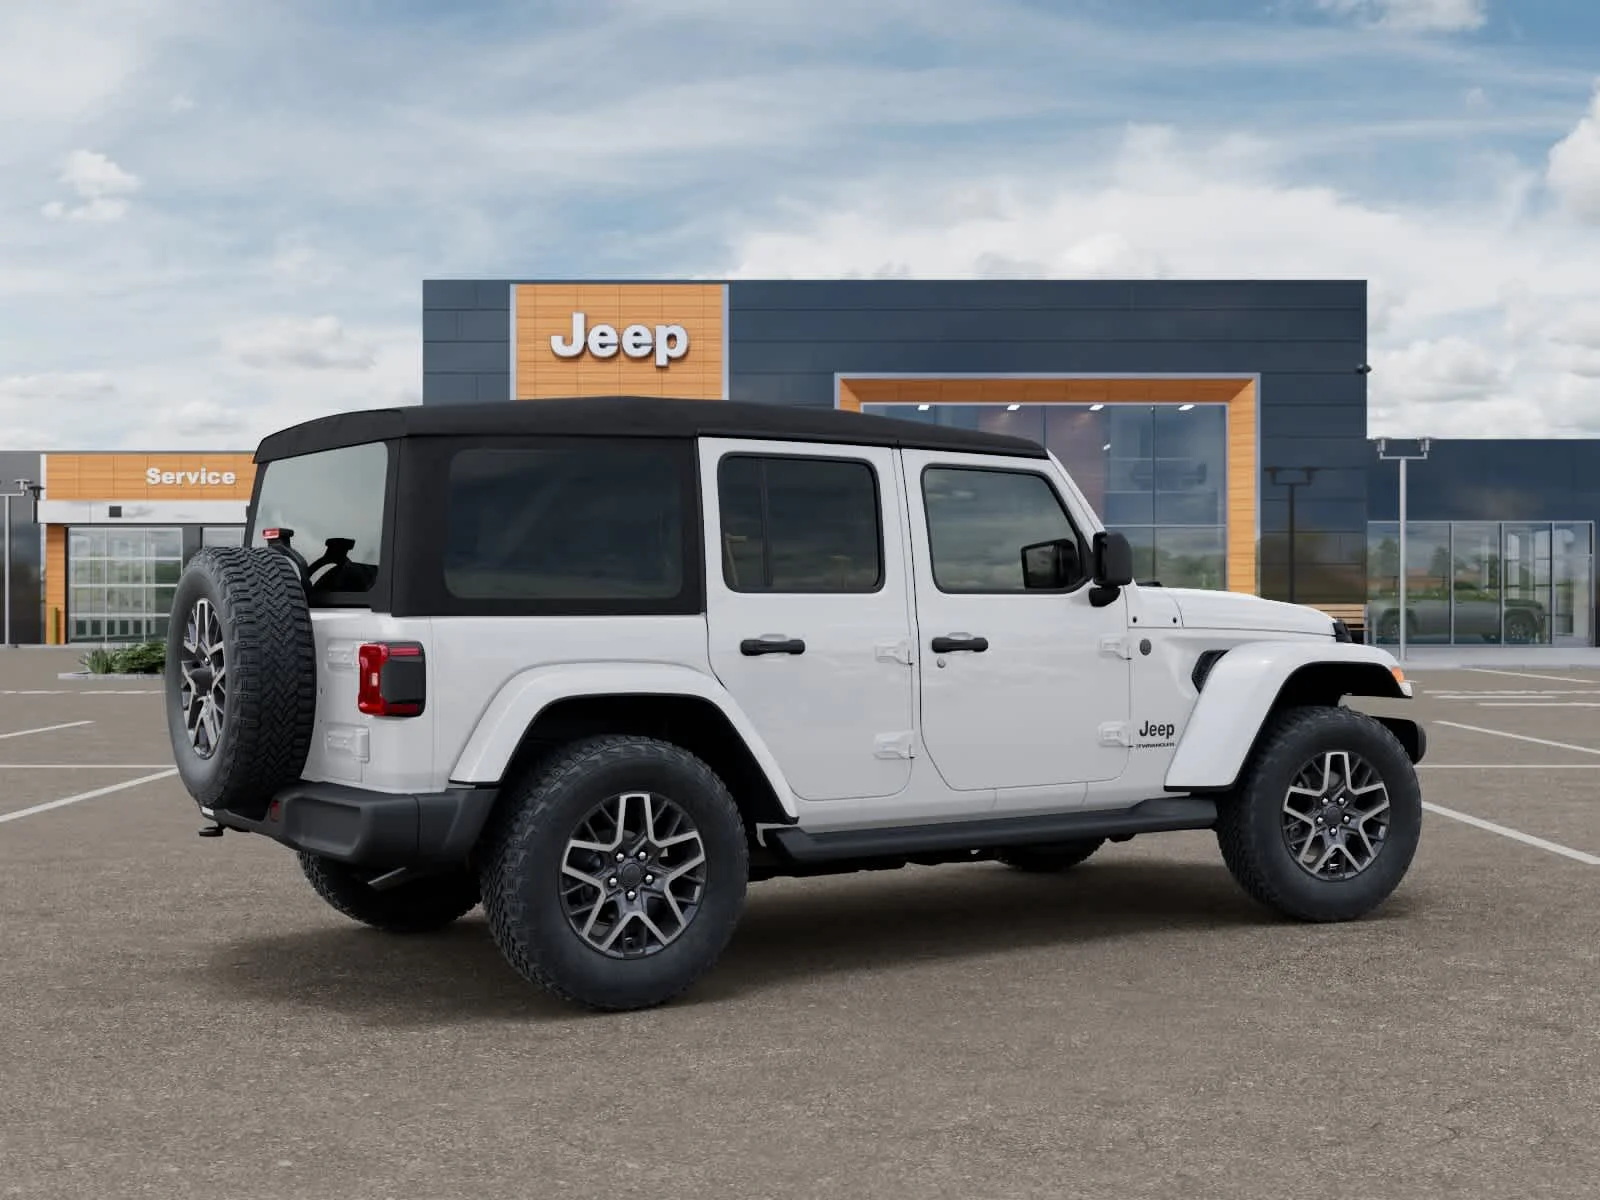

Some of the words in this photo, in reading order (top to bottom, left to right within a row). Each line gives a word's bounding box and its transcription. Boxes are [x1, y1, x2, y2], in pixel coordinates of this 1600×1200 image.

[550, 312, 689, 368] Jeep
[146, 465, 236, 485] Service
[1139, 720, 1175, 739] Jeep
